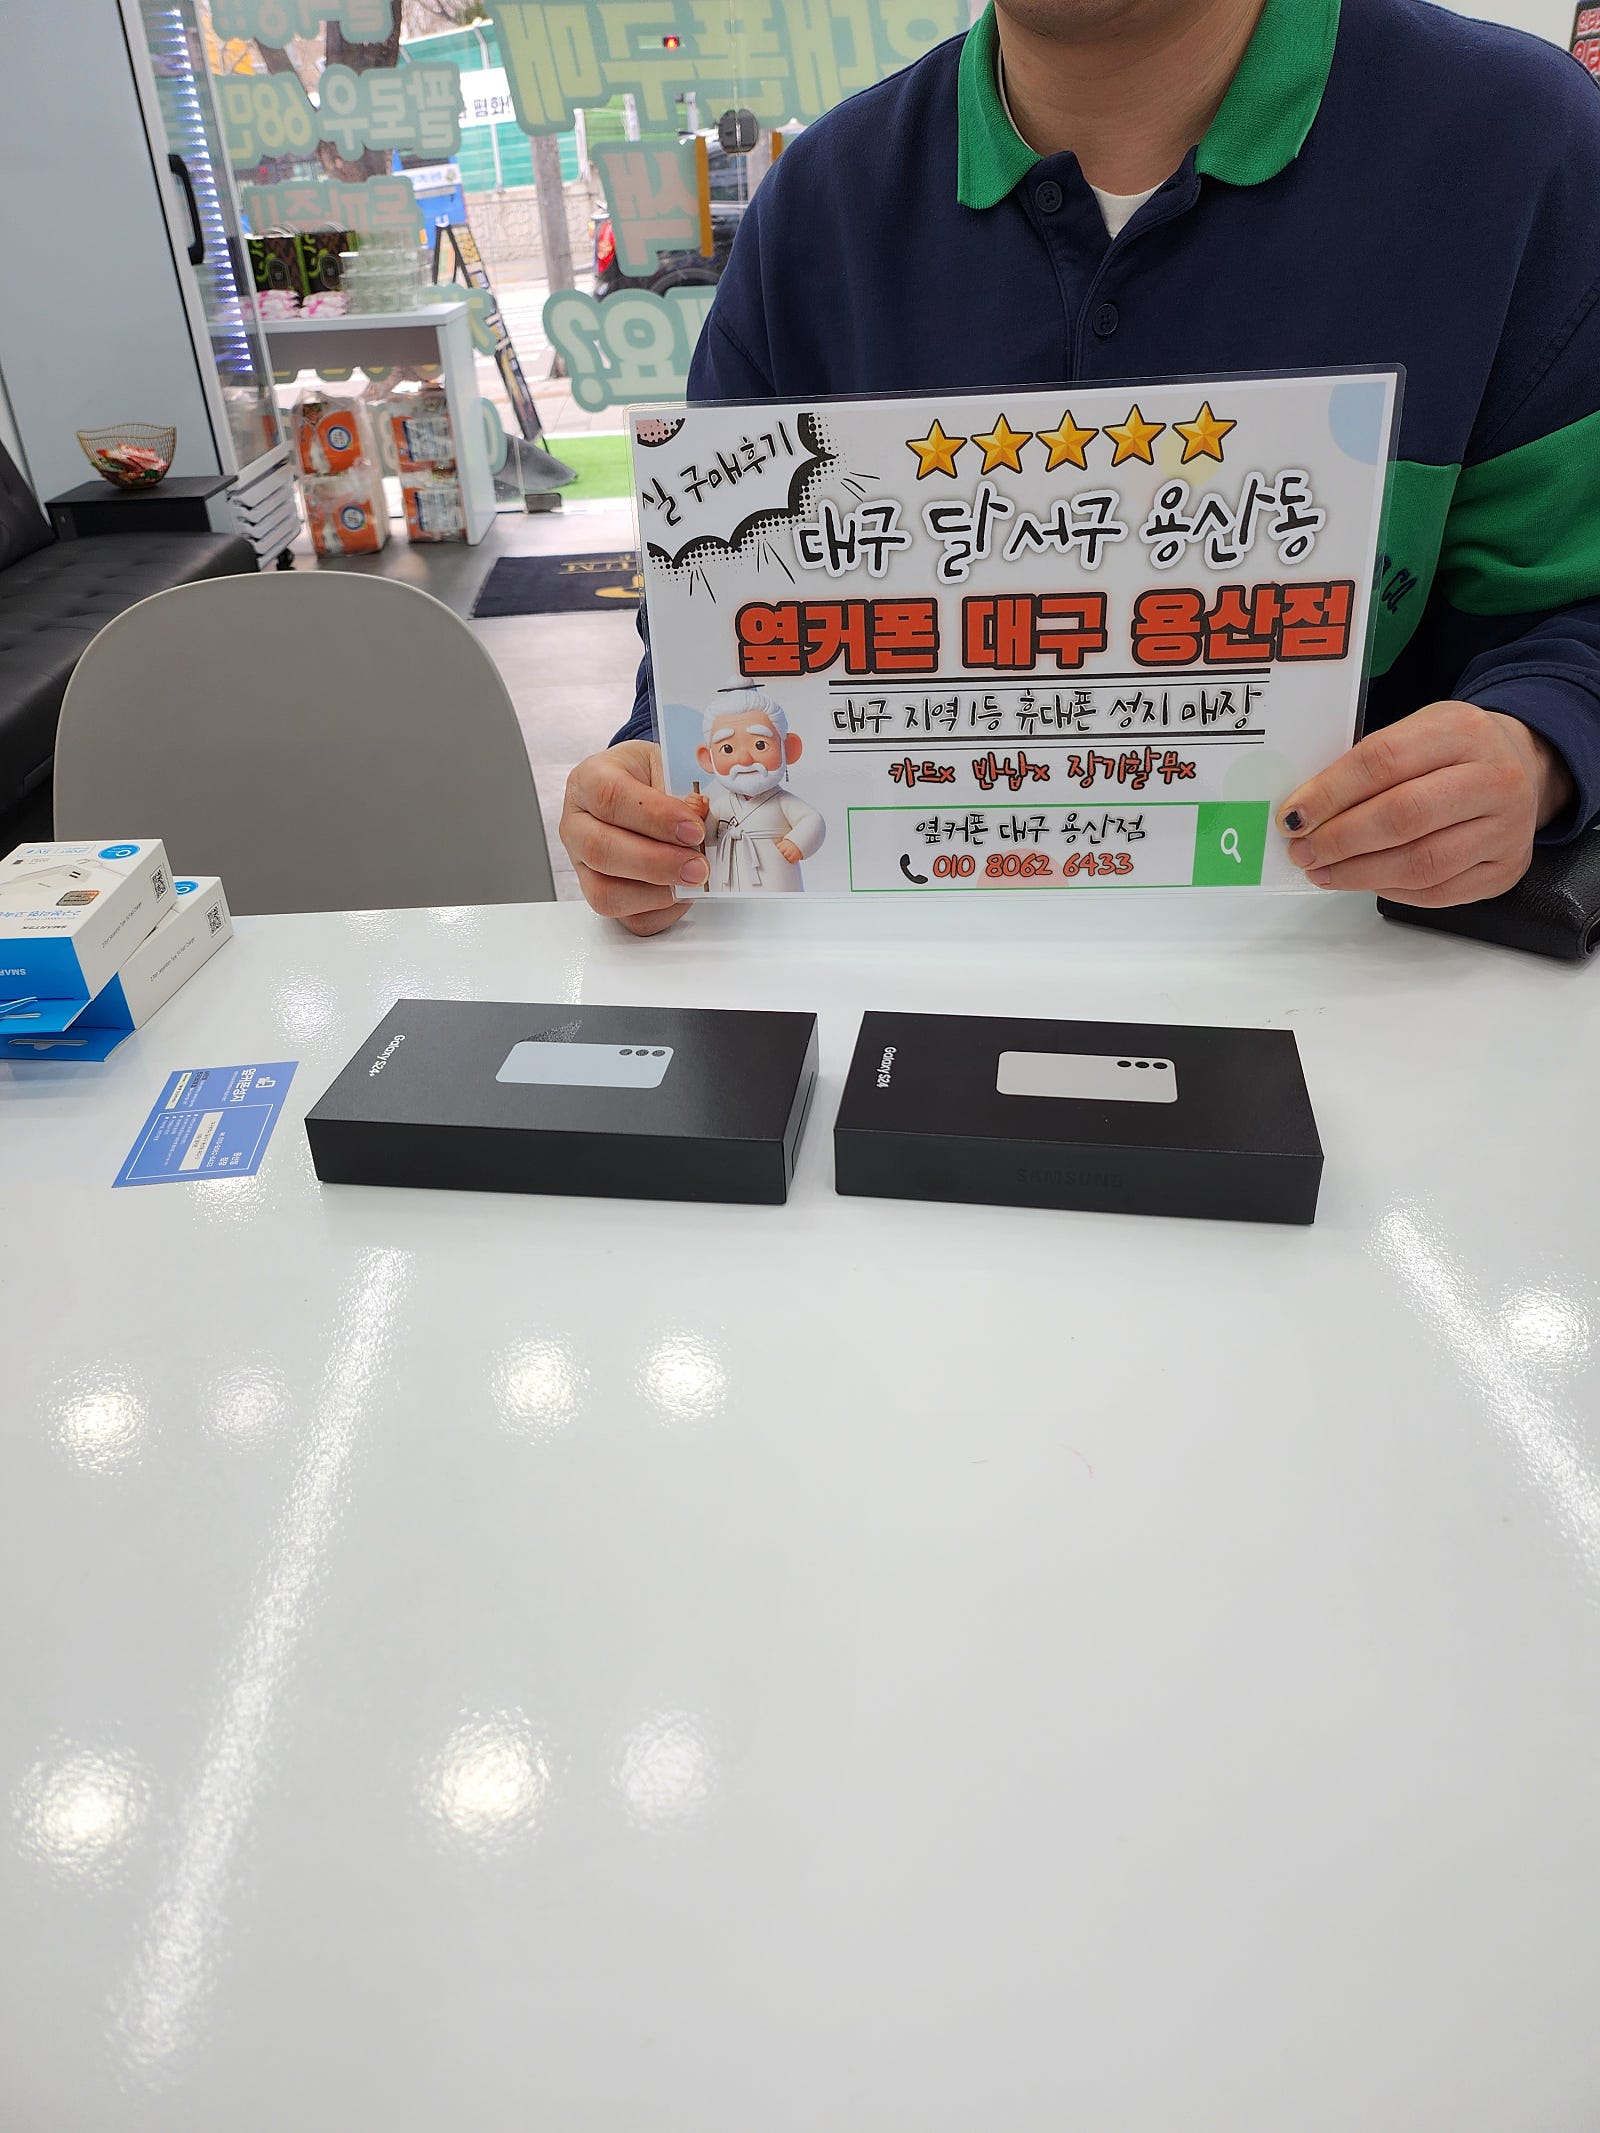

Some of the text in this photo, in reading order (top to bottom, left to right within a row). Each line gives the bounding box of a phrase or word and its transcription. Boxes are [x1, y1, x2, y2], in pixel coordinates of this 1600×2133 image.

[641, 421, 794, 527] 실 구매후기
[800, 476, 1319, 578] 대구 달서구 용산동
[736, 597, 939, 677] 옆커폰
[961, 591, 1108, 670] 대구
[1131, 580, 1357, 668] 용산점
[833, 699, 893, 734] 대구
[904, 696, 959, 732] 지역
[1015, 688, 1097, 735] 휴대폰
[1109, 691, 1169, 728] 성지
[1181, 684, 1263, 729] 매장
[915, 812, 1147, 845] 옆커폰 대구 용산점
[933, 852, 1134, 878] 010 8062 6433
[369, 1034, 406, 1077] Galaxy S24+
[876, 1046, 897, 1088] Galaxy S24
